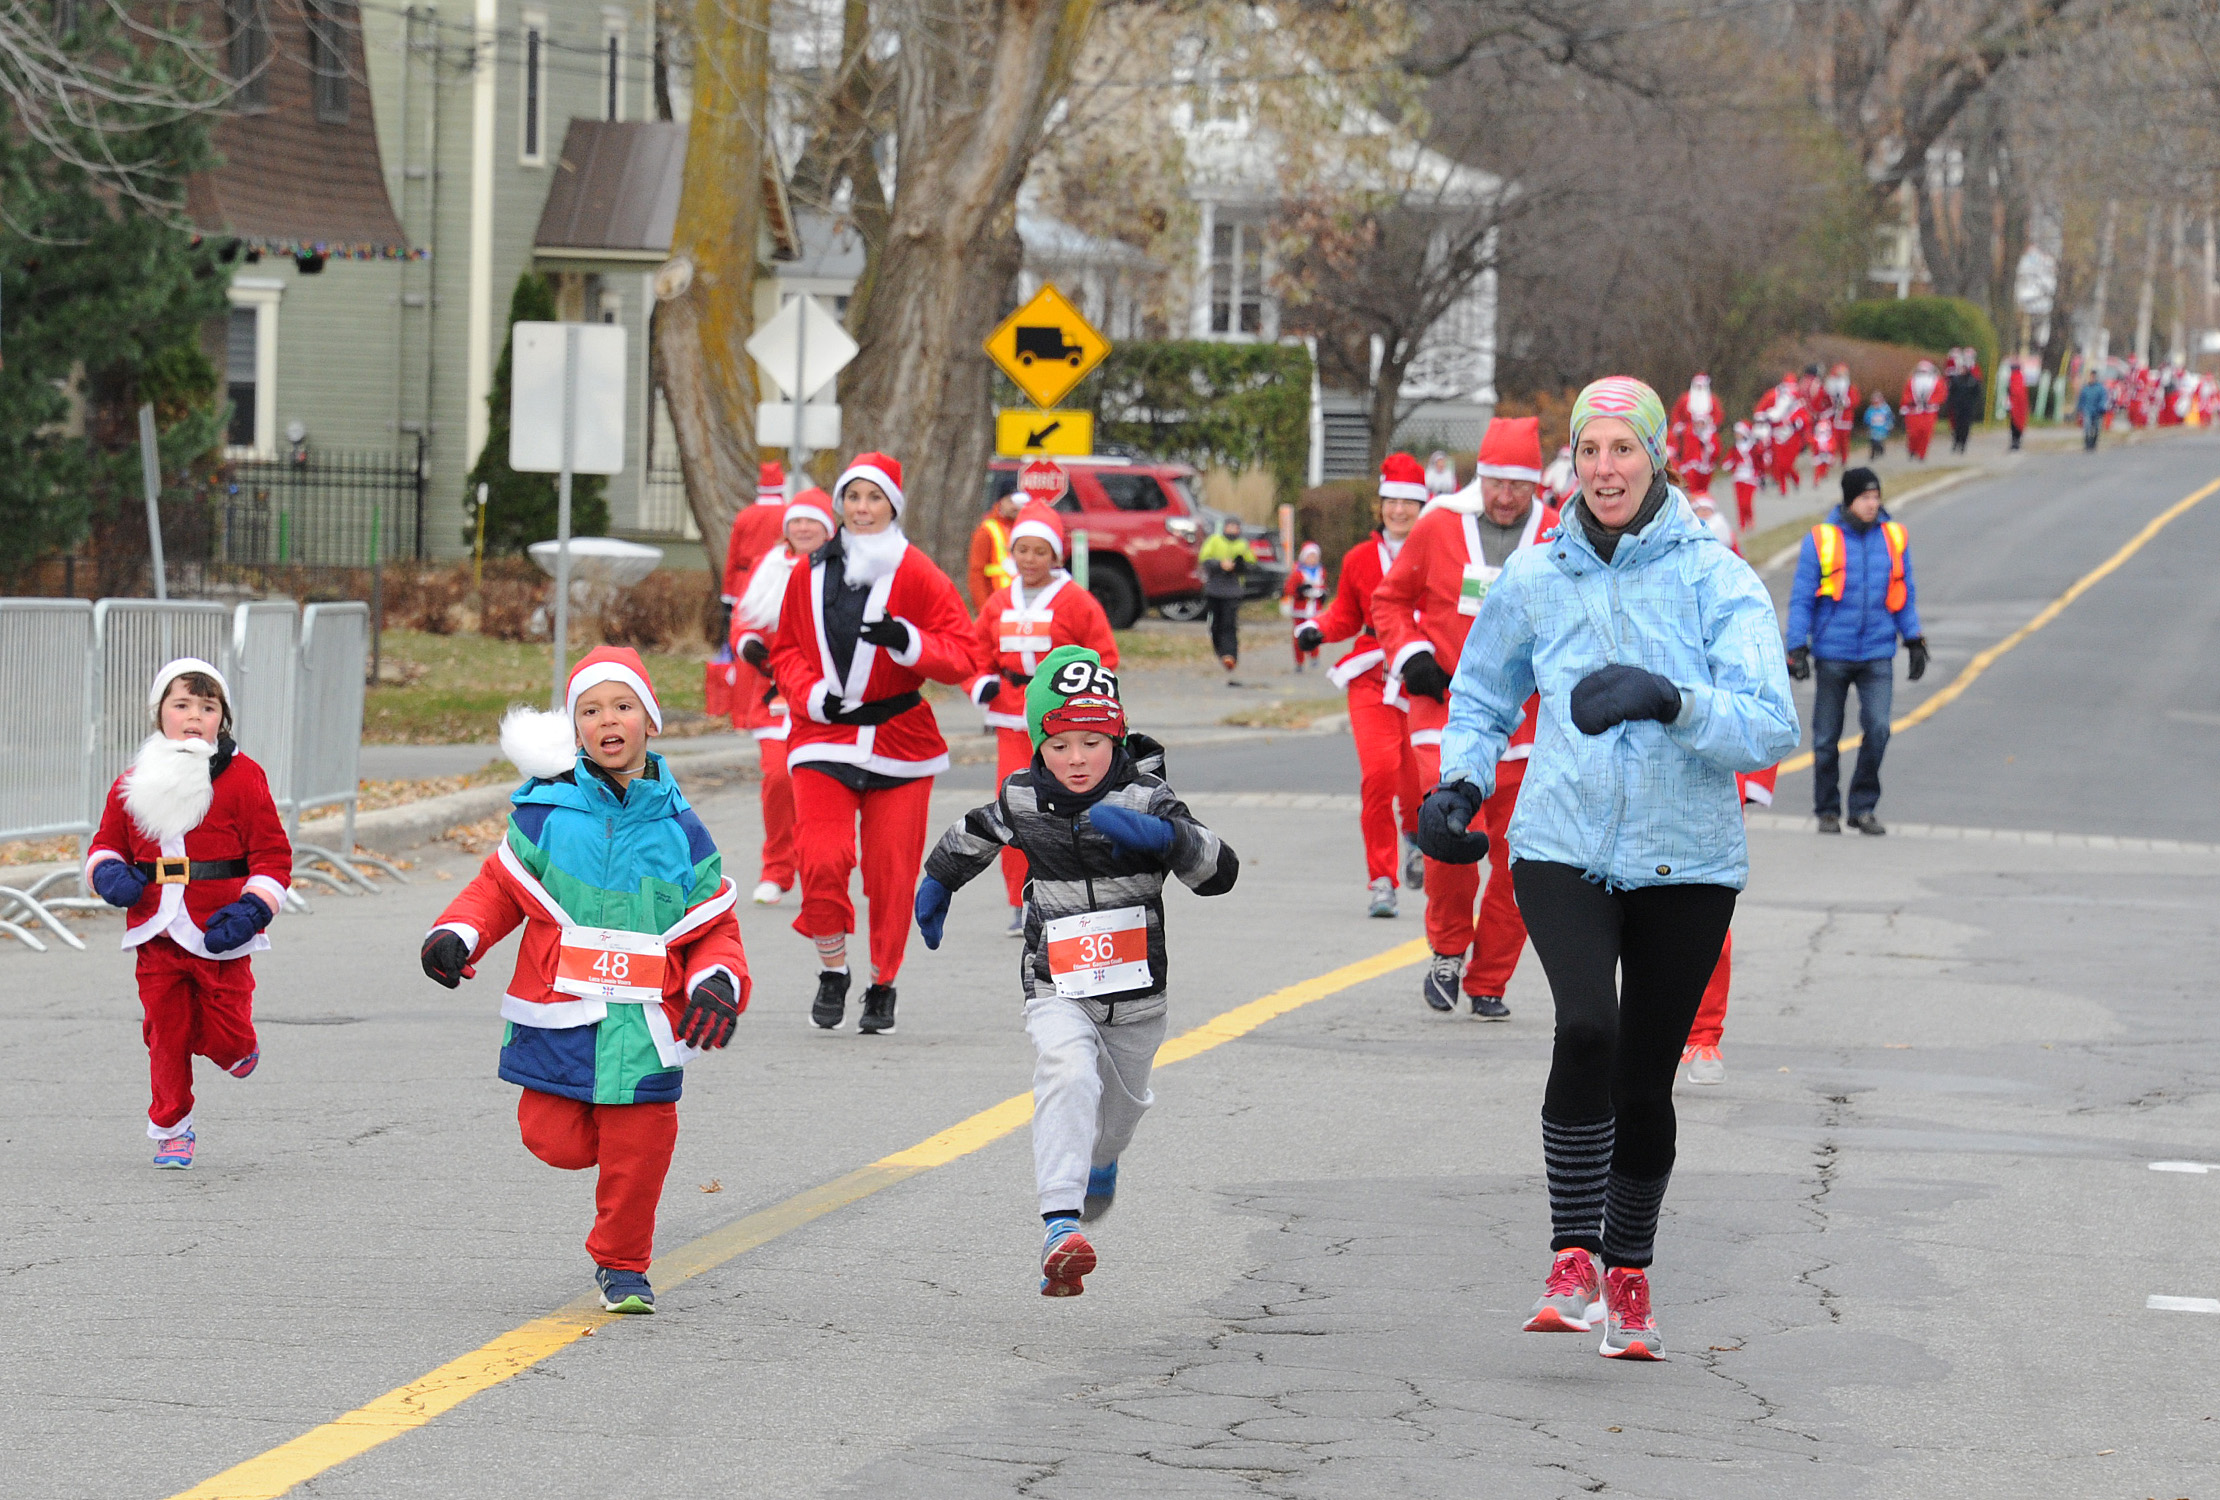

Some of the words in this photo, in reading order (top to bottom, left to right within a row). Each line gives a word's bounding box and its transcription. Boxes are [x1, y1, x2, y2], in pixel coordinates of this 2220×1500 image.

[1058, 661, 1115, 698] 95
[1080, 934, 1114, 962] 36
[593, 951, 629, 978] 48
